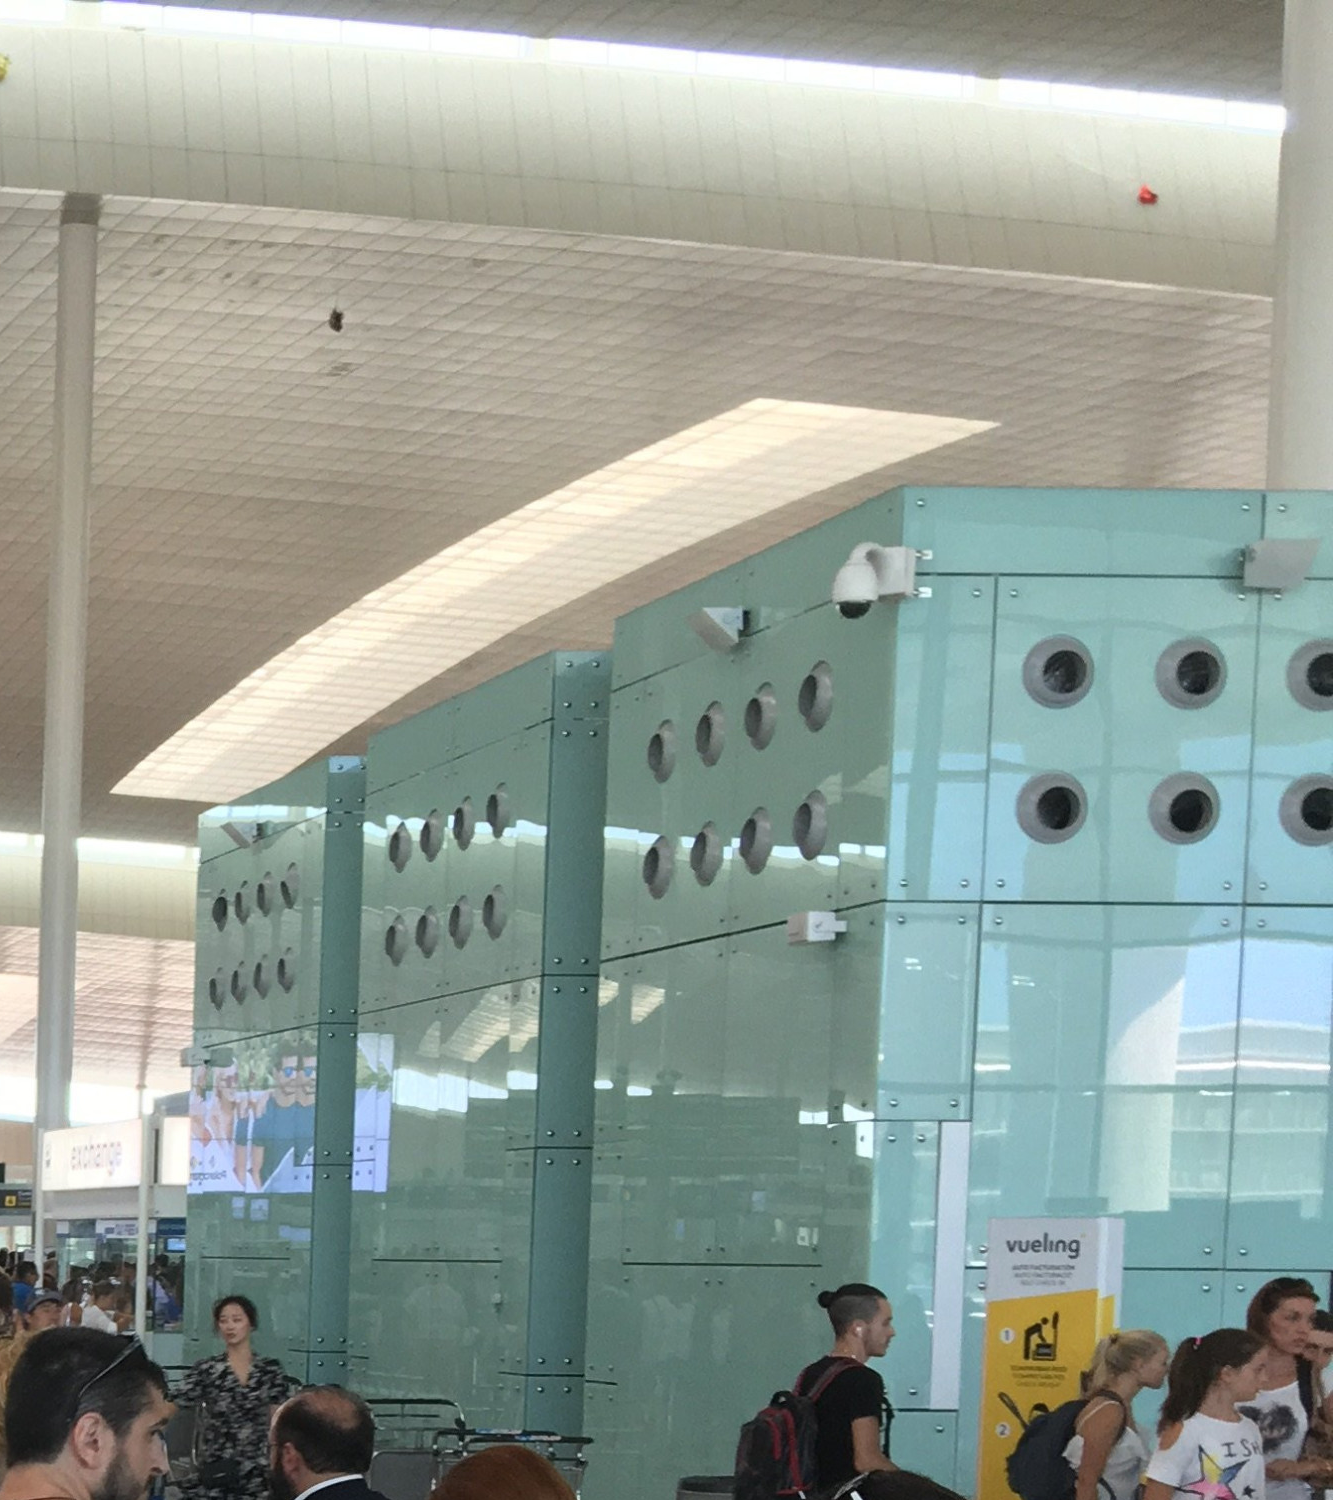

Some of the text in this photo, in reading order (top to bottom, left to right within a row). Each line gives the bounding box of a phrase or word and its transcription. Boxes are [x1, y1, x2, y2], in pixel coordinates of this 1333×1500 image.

[1006, 1232, 1080, 1259] vueling
[999, 1424, 1007, 1436] 2
[1221, 1442, 1237, 1457] I
